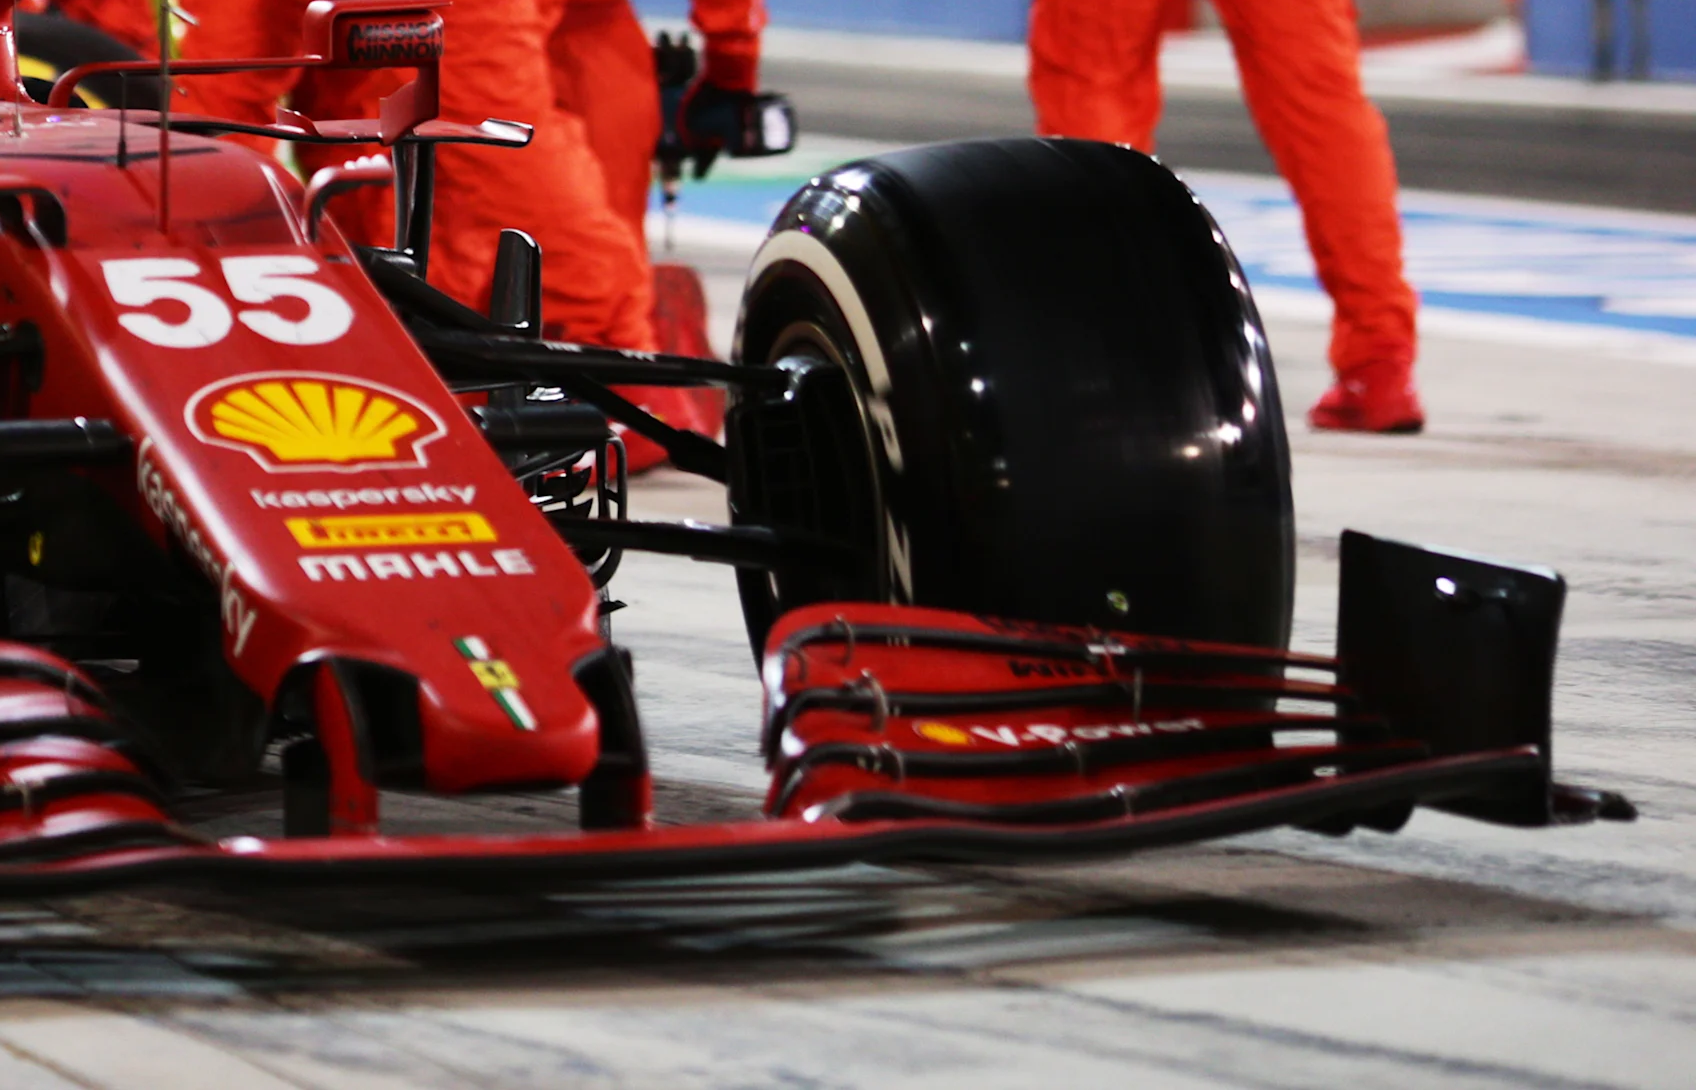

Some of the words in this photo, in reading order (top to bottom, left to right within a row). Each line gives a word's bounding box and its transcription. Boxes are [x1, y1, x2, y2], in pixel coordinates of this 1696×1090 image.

[101, 254, 354, 349] 55
[248, 482, 477, 510] kaspersky
[296, 548, 537, 582] MAHLE
[969, 716, 1207, 748] V-Power
